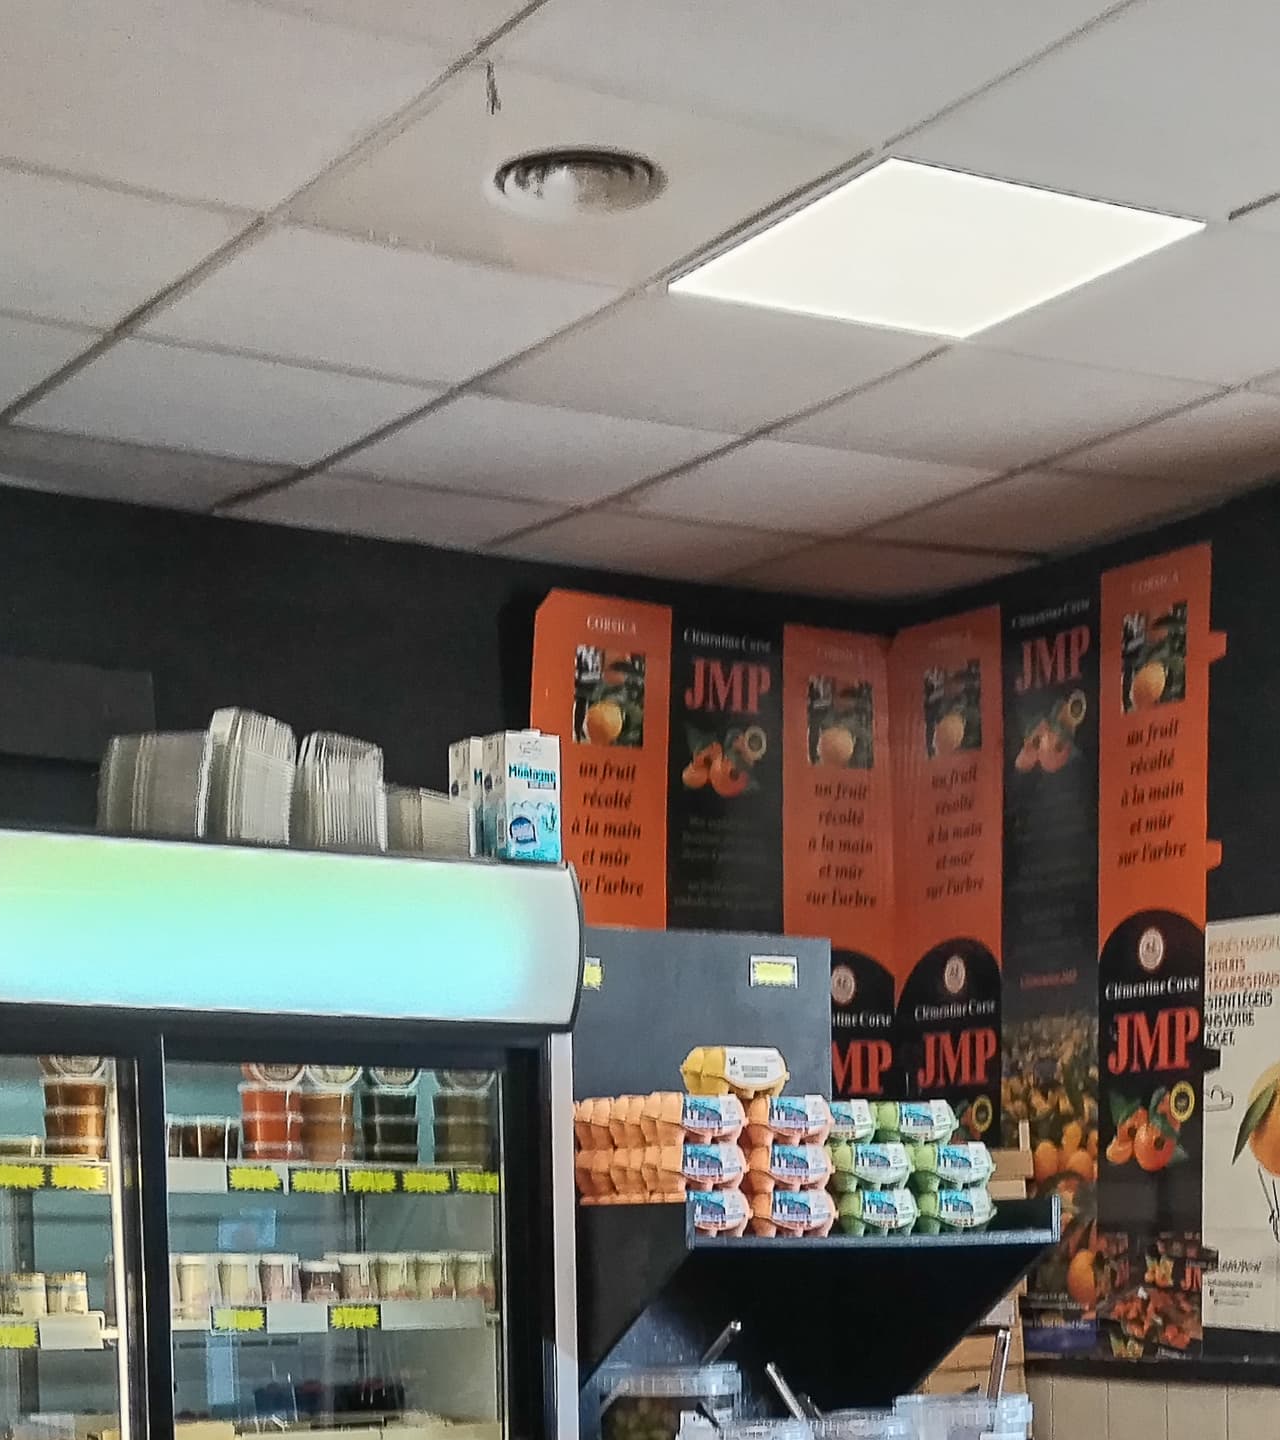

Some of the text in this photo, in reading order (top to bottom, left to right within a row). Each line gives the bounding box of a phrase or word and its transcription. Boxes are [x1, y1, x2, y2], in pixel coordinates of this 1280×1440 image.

[587, 616, 638, 634] CORSICA
[1015, 625, 1090, 694] JMP
[684, 657, 771, 714] JMP
[1127, 718, 1179, 747] un fruit
[579, 762, 636, 784] un fruit
[1130, 749, 1175, 776] récolté
[949, 766, 978, 791] fruit
[583, 791, 631, 810] récolté
[815, 783, 868, 800] un fruit
[1132, 784, 1144, 806] la
[1148, 780, 1184, 800] main
[571, 815, 641, 840] à la main
[818, 808, 864, 827] récolté
[1130, 817, 1141, 836] et
[821, 834, 835, 851] la
[838, 837, 873, 854] main
[582, 849, 594, 866] et
[1118, 853, 1138, 868] sur
[818, 863, 831, 878] et
[1105, 976, 1200, 1001] Clémentine Corse
[860, 1010, 892, 1028] Corse
[914, 997, 996, 1022] Clémentine Corse
[1108, 1006, 1200, 1075] JMP
[832, 1039, 893, 1095] MP
[917, 1027, 997, 1089] JMP
